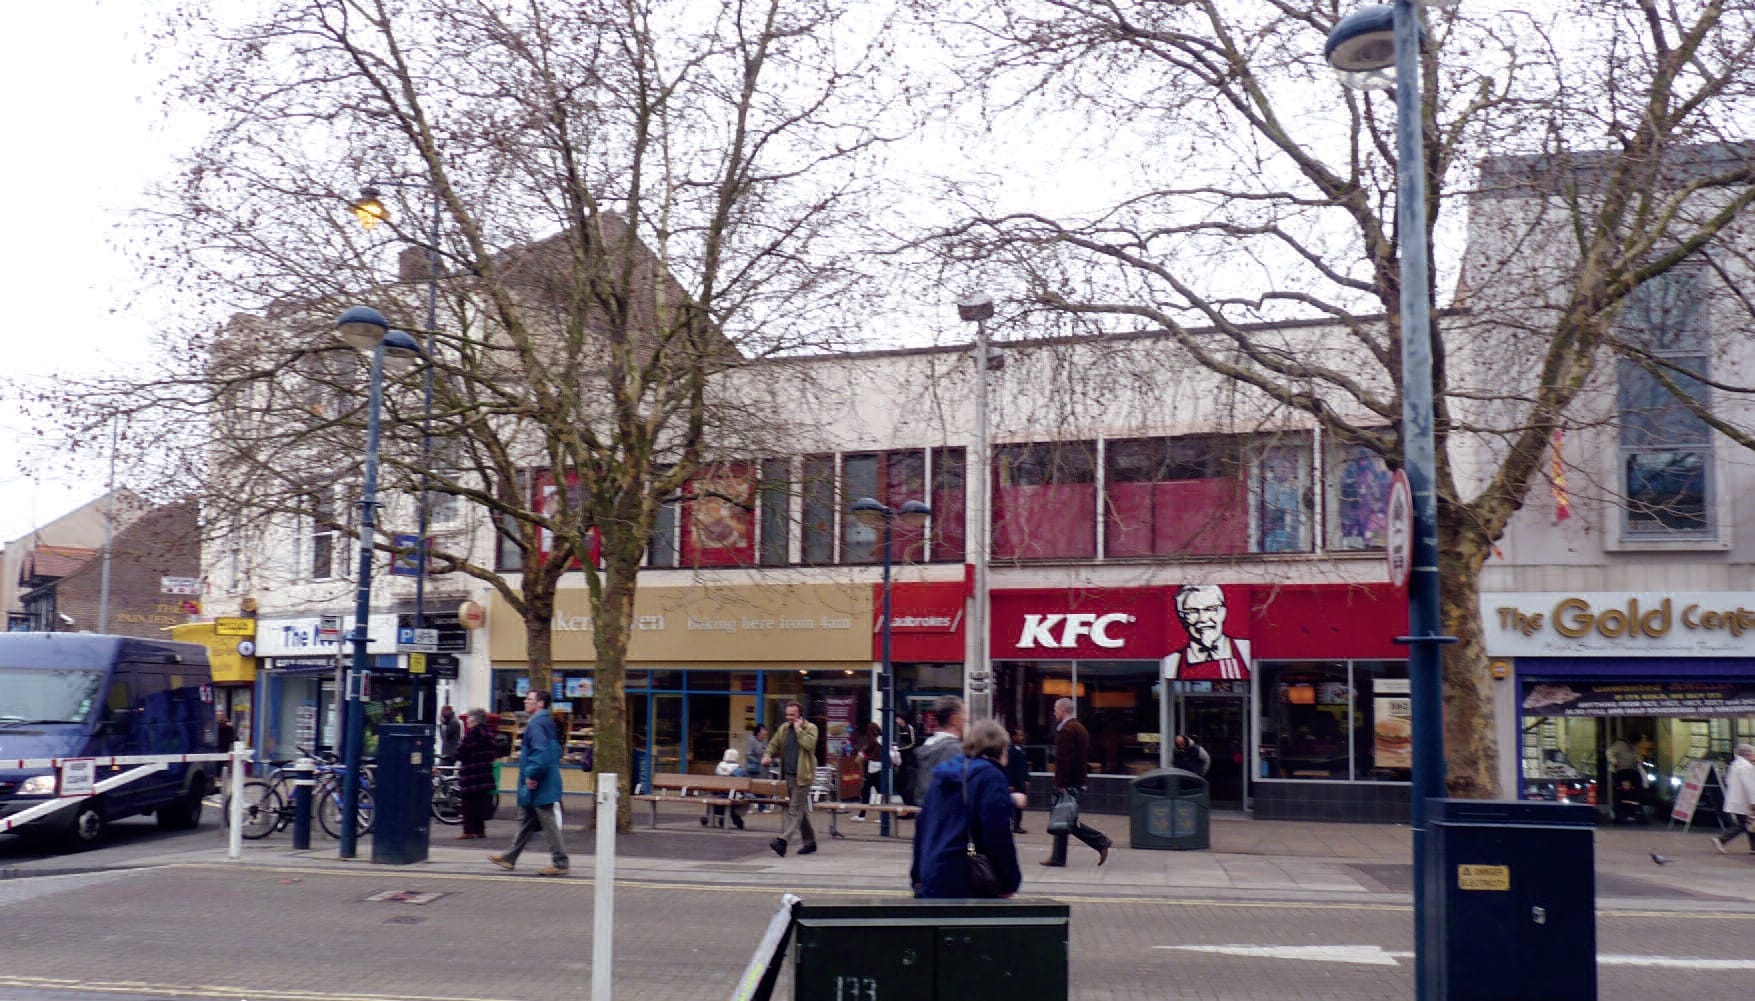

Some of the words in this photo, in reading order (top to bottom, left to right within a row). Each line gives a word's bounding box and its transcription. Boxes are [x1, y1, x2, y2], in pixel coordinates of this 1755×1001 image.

[687, 615, 737, 633] Baking
[742, 615, 775, 629] here
[779, 615, 815, 629] from
[820, 615, 851, 629] 4am
[889, 615, 952, 627] adbrokes
[1015, 612, 1129, 648] KFC
[1496, 606, 1543, 637] The
[1552, 597, 1672, 638] Gold
